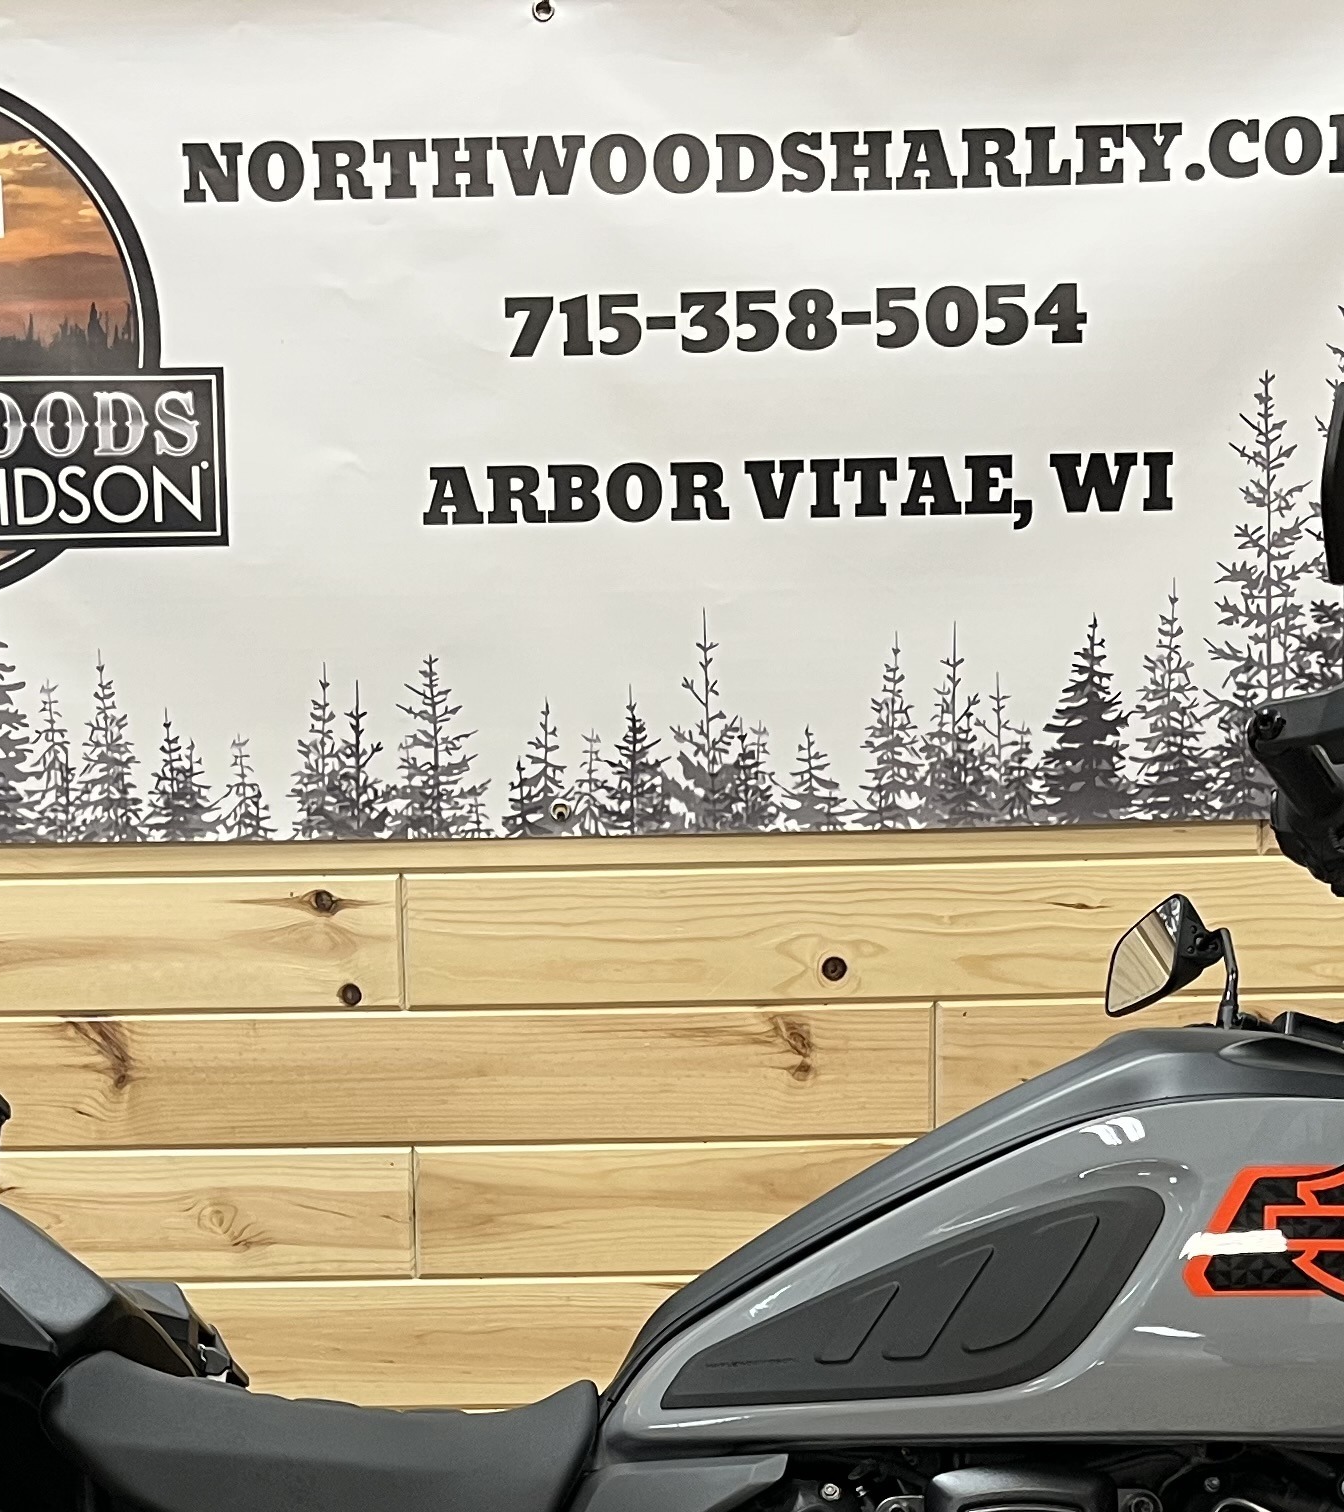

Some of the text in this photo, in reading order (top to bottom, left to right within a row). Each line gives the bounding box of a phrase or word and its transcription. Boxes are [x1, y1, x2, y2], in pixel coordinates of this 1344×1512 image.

[504, 282, 1088, 358] 715-358-5054
[422, 451, 1174, 531] ARBOR VITAE, WI
